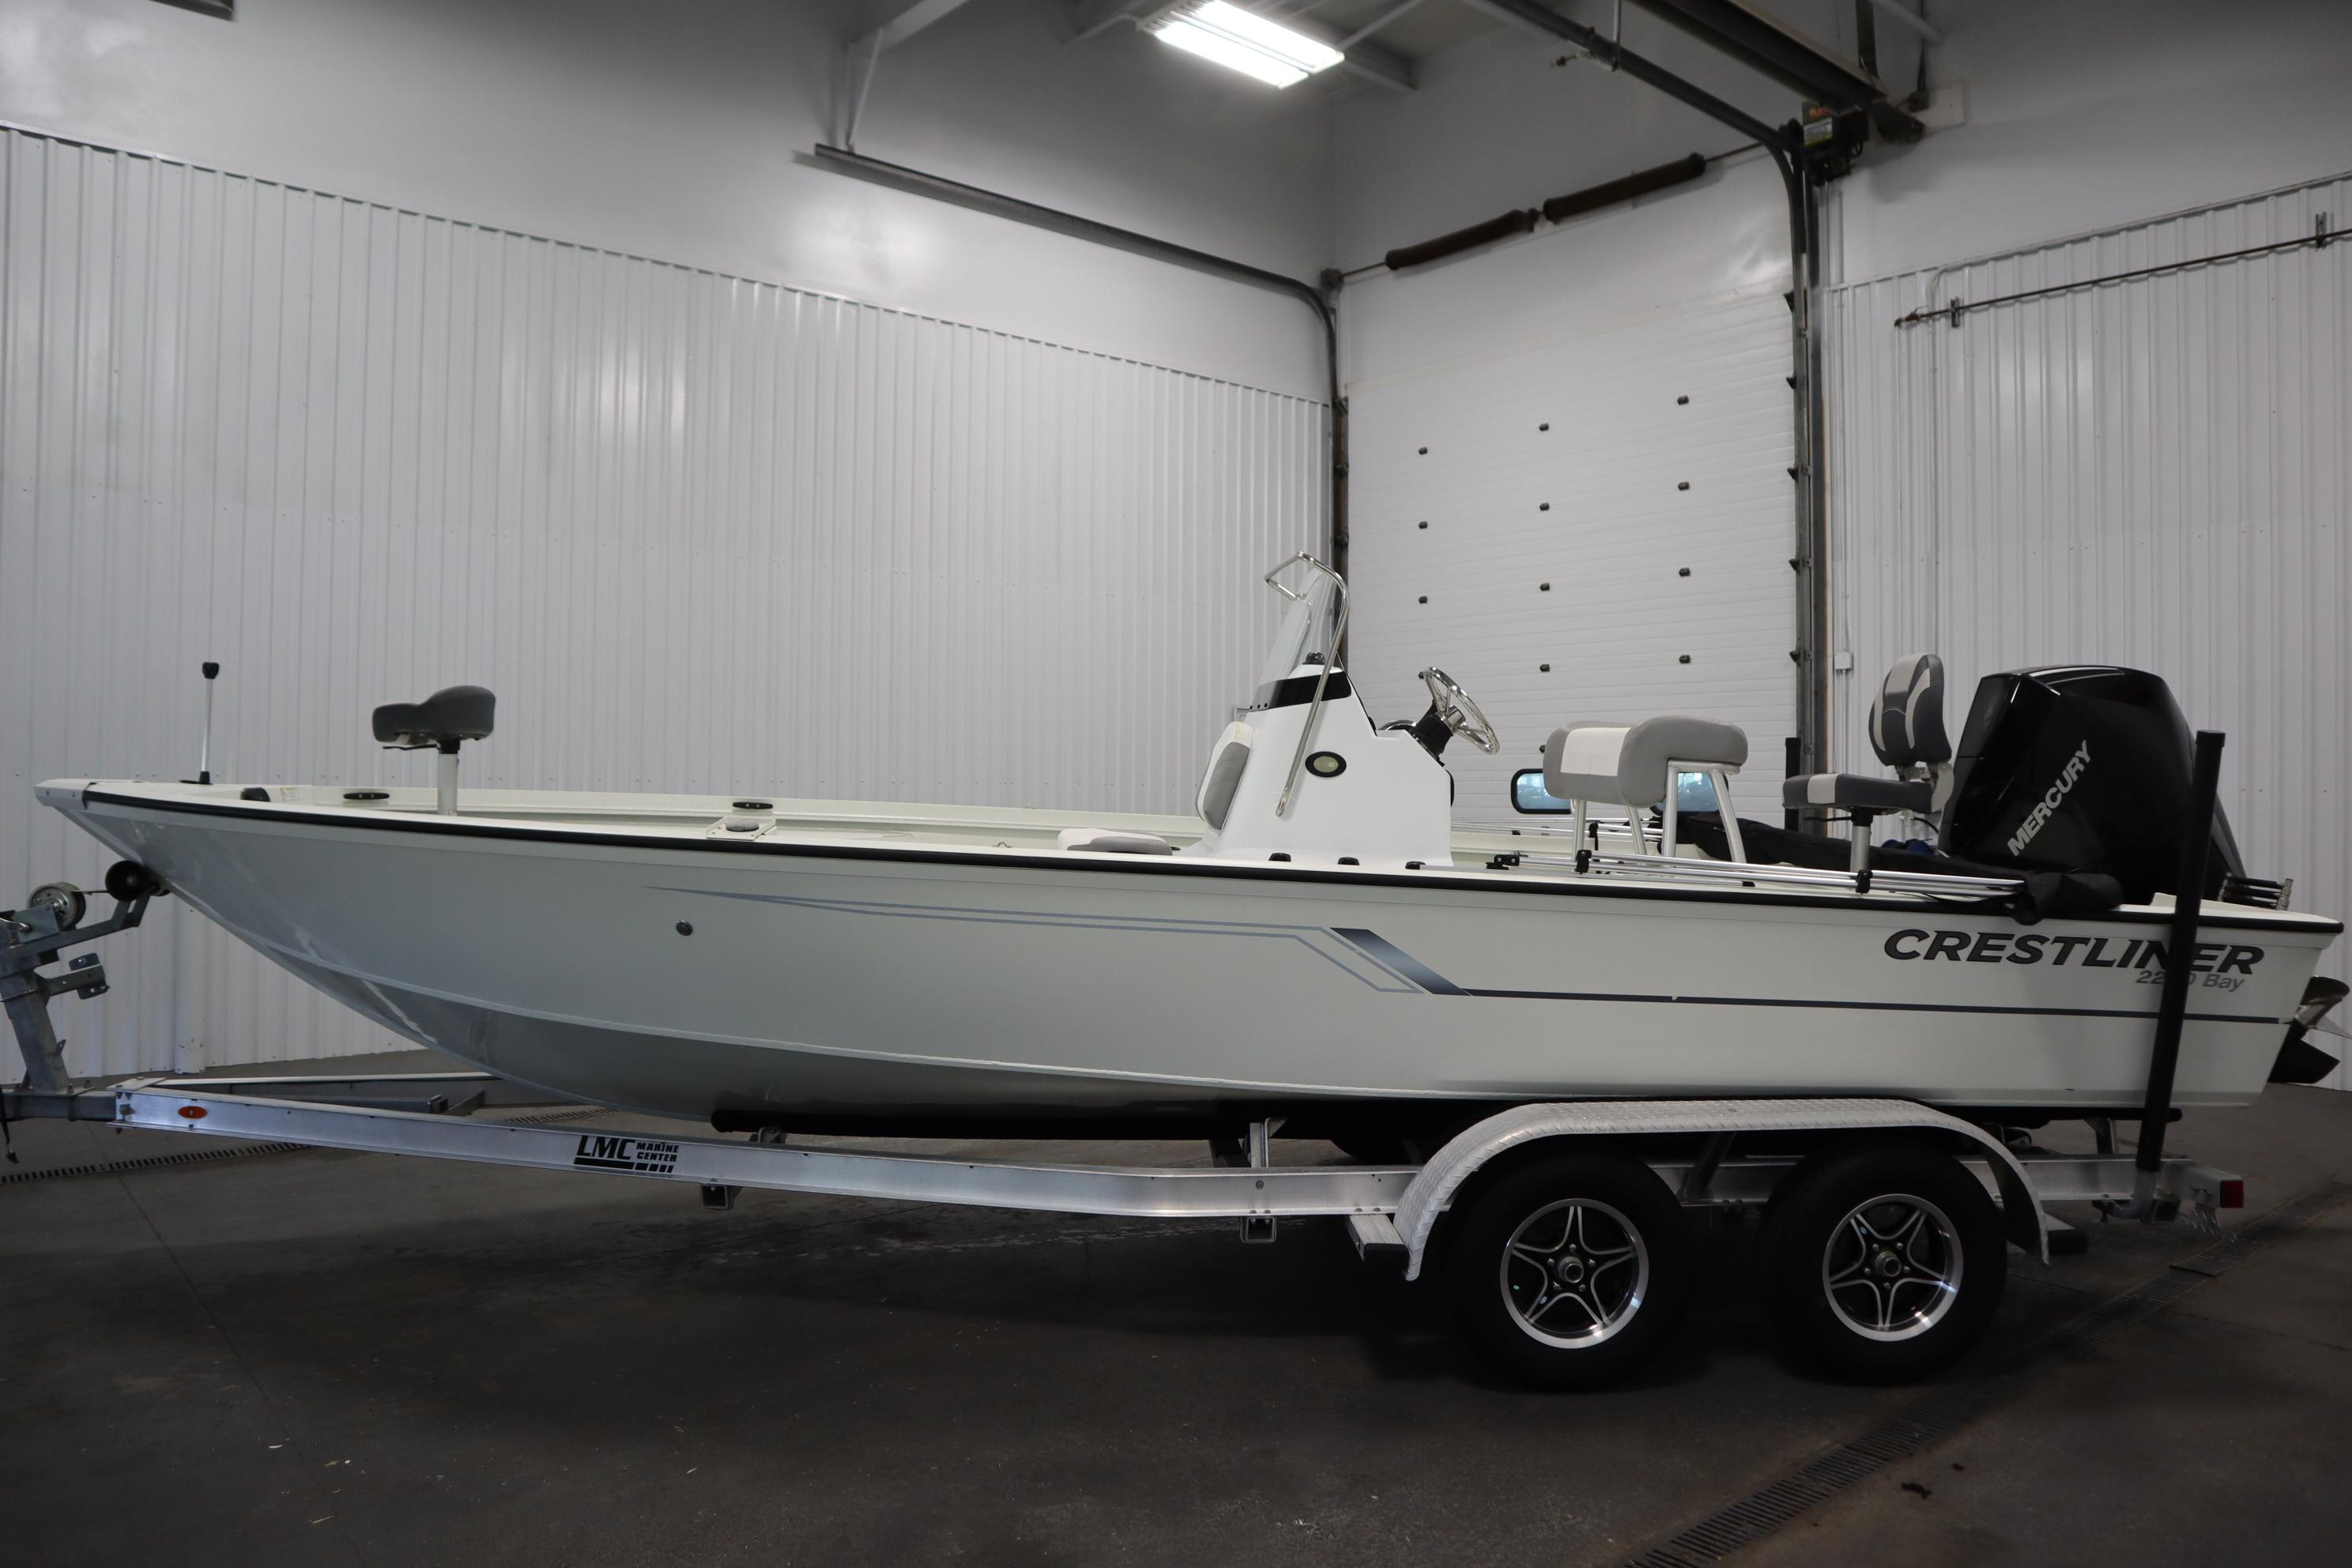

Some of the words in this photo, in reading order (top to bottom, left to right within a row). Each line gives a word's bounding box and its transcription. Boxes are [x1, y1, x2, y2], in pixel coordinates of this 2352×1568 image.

[2007, 739, 2092, 857] MERCURY
[1883, 929, 2264, 975] CRESTLINER
[2135, 971, 2197, 986] 22
[2203, 974, 2245, 993] Bay
[576, 1135, 635, 1160] LMC
[636, 1141, 680, 1153] MARINE
[636, 1152, 677, 1163] CENTER
